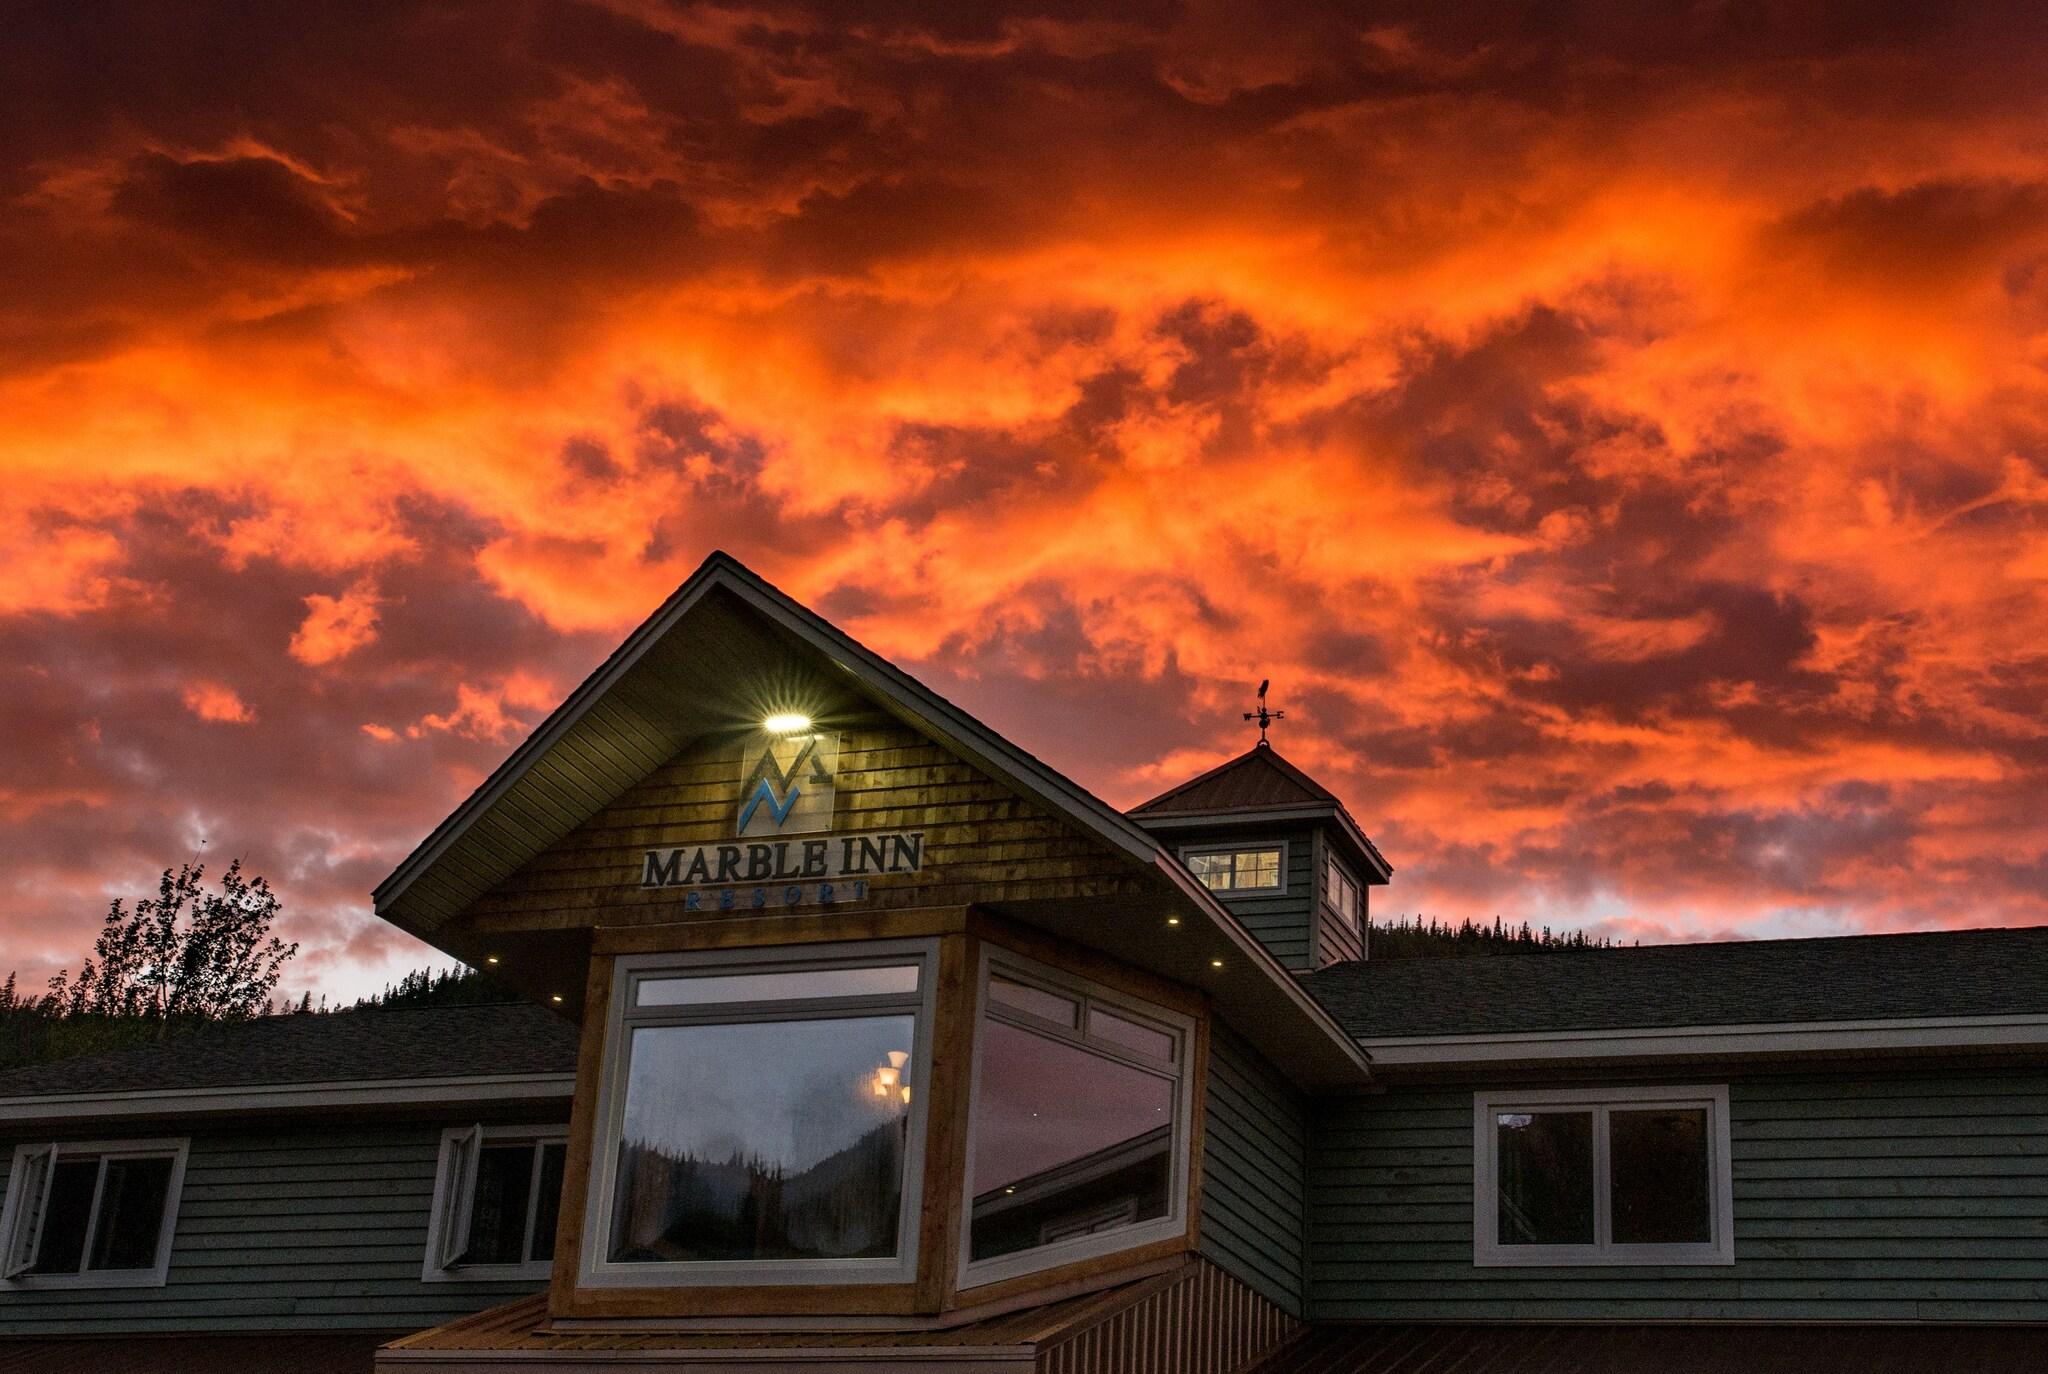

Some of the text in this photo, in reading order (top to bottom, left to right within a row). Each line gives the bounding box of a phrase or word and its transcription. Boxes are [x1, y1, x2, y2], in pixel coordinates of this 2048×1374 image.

[642, 833, 924, 887] MARBLE INN
[685, 880, 867, 911] RESORT
